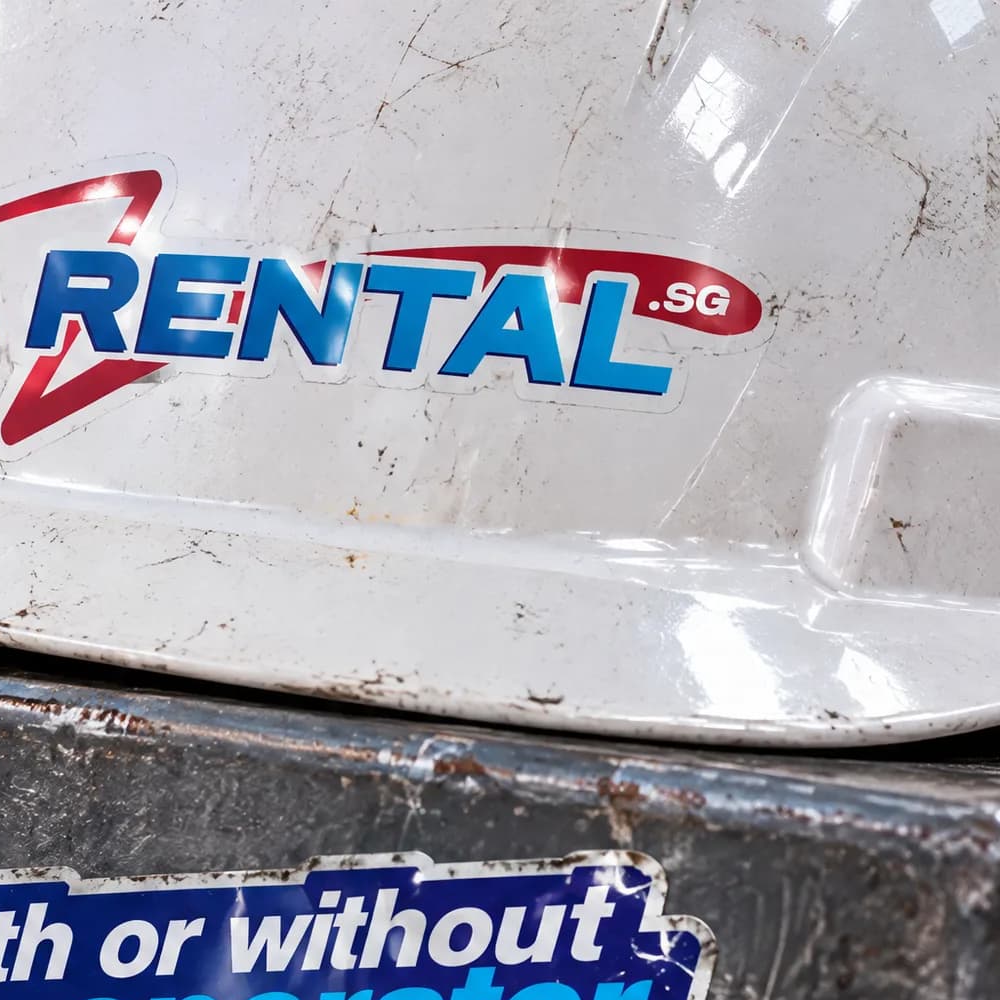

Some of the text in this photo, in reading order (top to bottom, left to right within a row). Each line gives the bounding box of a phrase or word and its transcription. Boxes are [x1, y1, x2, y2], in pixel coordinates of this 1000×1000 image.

[25, 250, 673, 395] RENTAL
[648, 281, 731, 317] .SG
[100, 917, 206, 979] or
[230, 886, 617, 973] without
